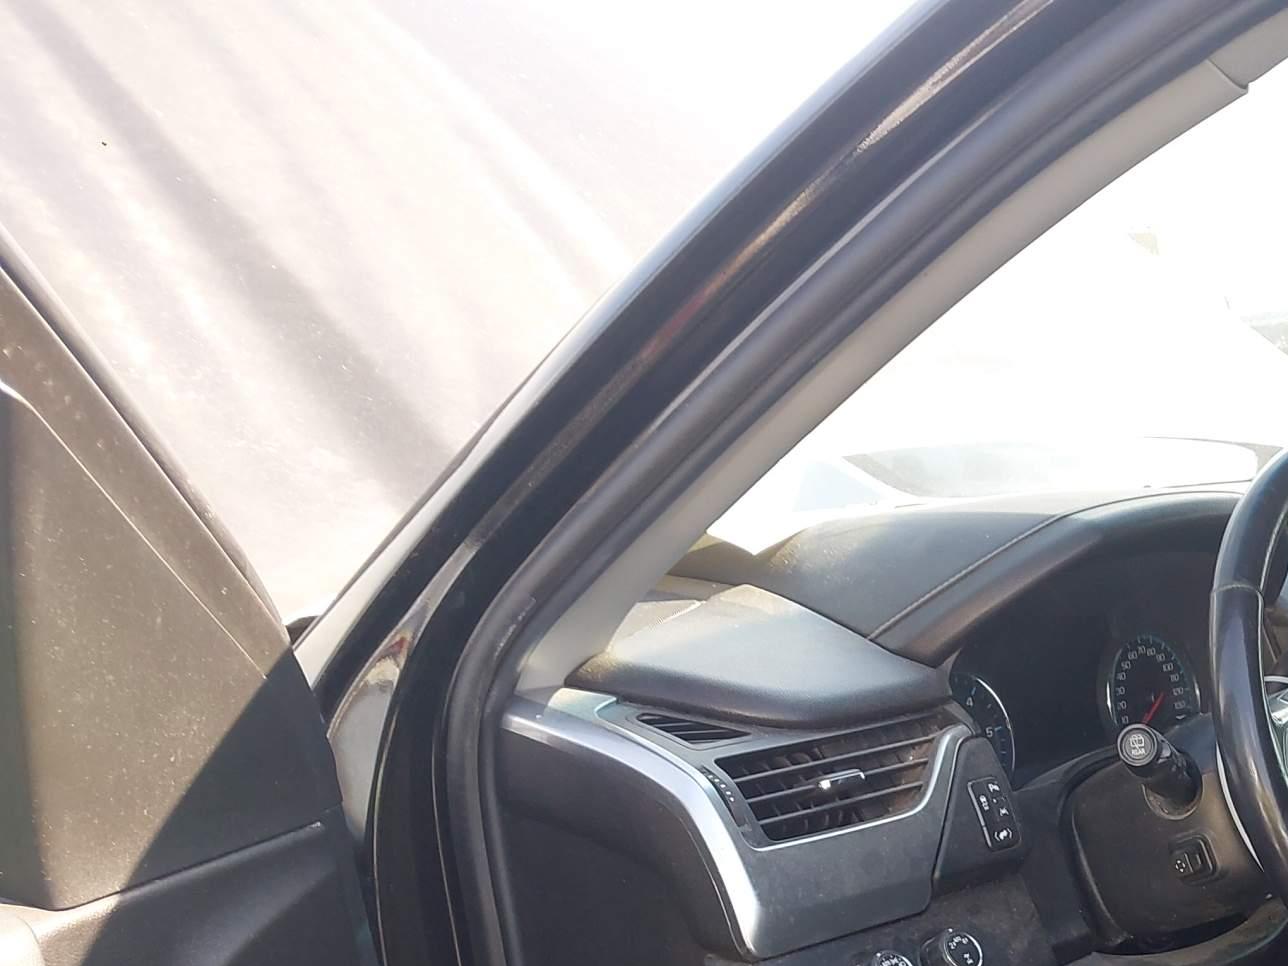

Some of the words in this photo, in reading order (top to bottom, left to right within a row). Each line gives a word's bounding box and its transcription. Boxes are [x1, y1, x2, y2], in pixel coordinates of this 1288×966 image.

[1138, 646, 1146, 654] 70
[1147, 648, 1156, 656] 80
[1128, 651, 1138, 660] 60
[1121, 661, 1131, 670] 50
[1163, 663, 1174, 672] 100
[966, 697, 974, 707] 4
[985, 727, 993, 737] 5
